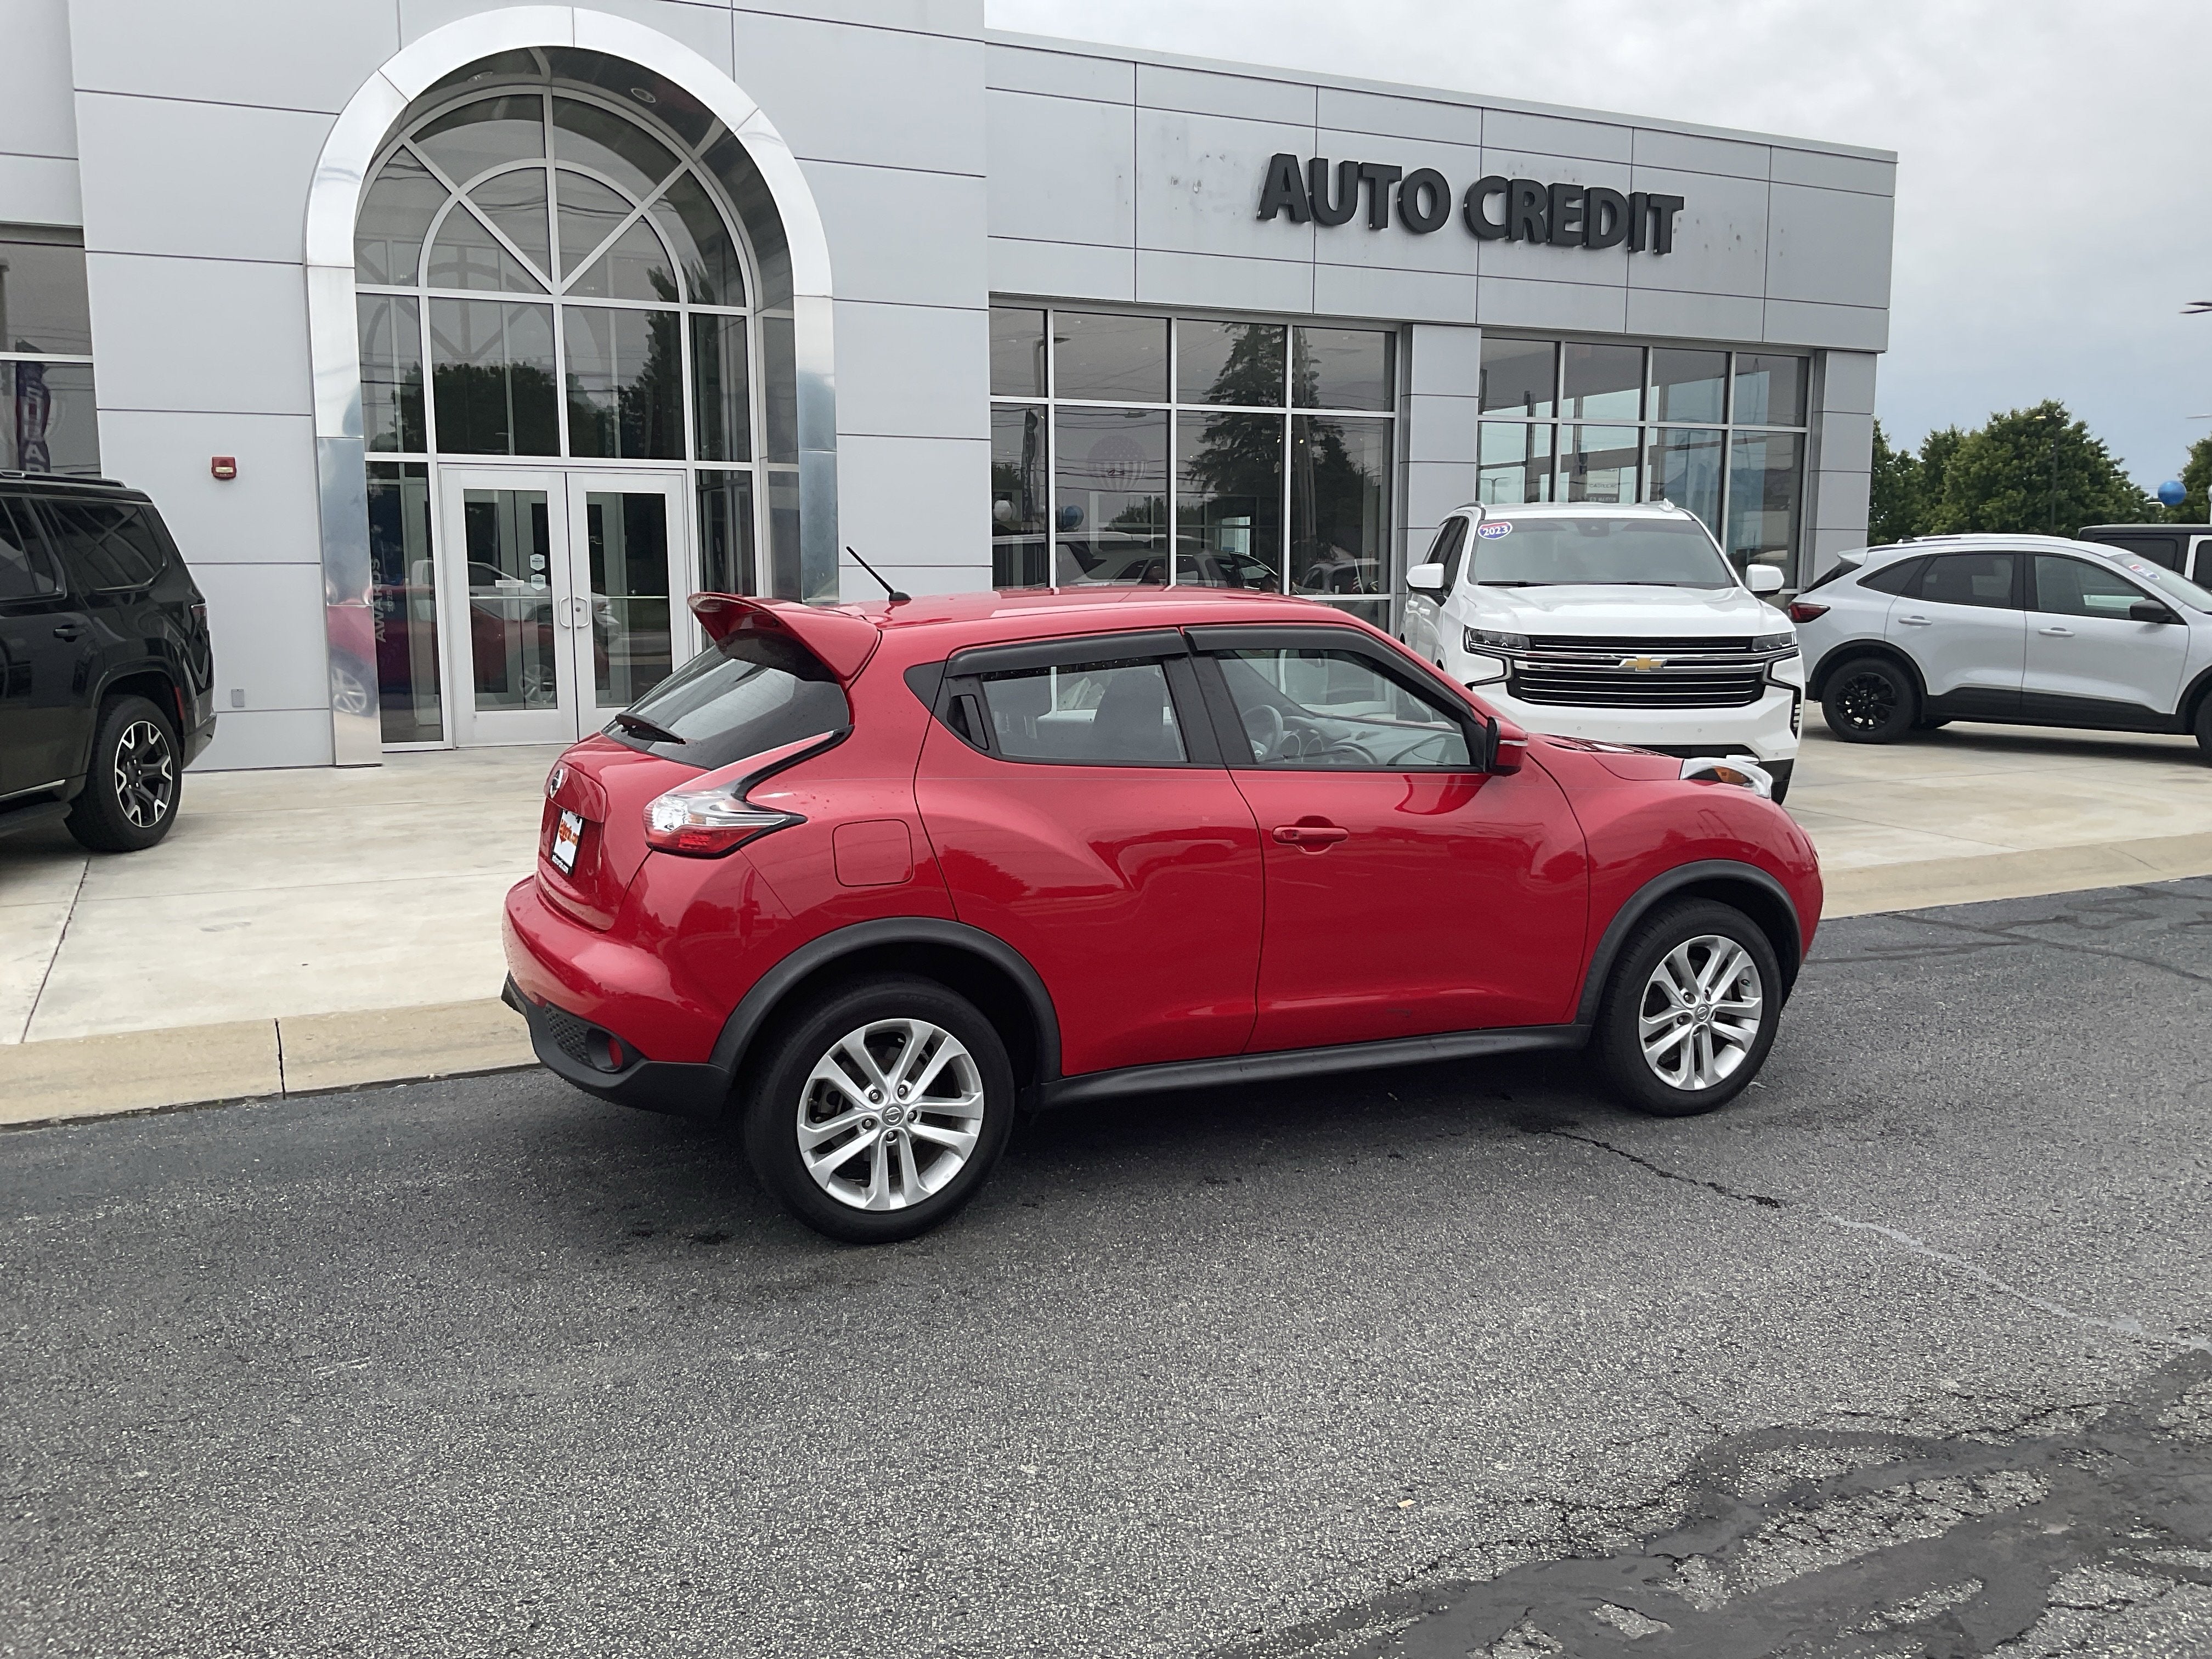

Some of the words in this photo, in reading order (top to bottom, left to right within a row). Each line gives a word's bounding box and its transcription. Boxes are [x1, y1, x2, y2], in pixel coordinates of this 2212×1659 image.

[1256, 153, 1451, 234] AUTO
[1463, 175, 1684, 255] CREDIT
[1482, 526, 1509, 537] 2023
[371, 558, 386, 643] AWARDS
